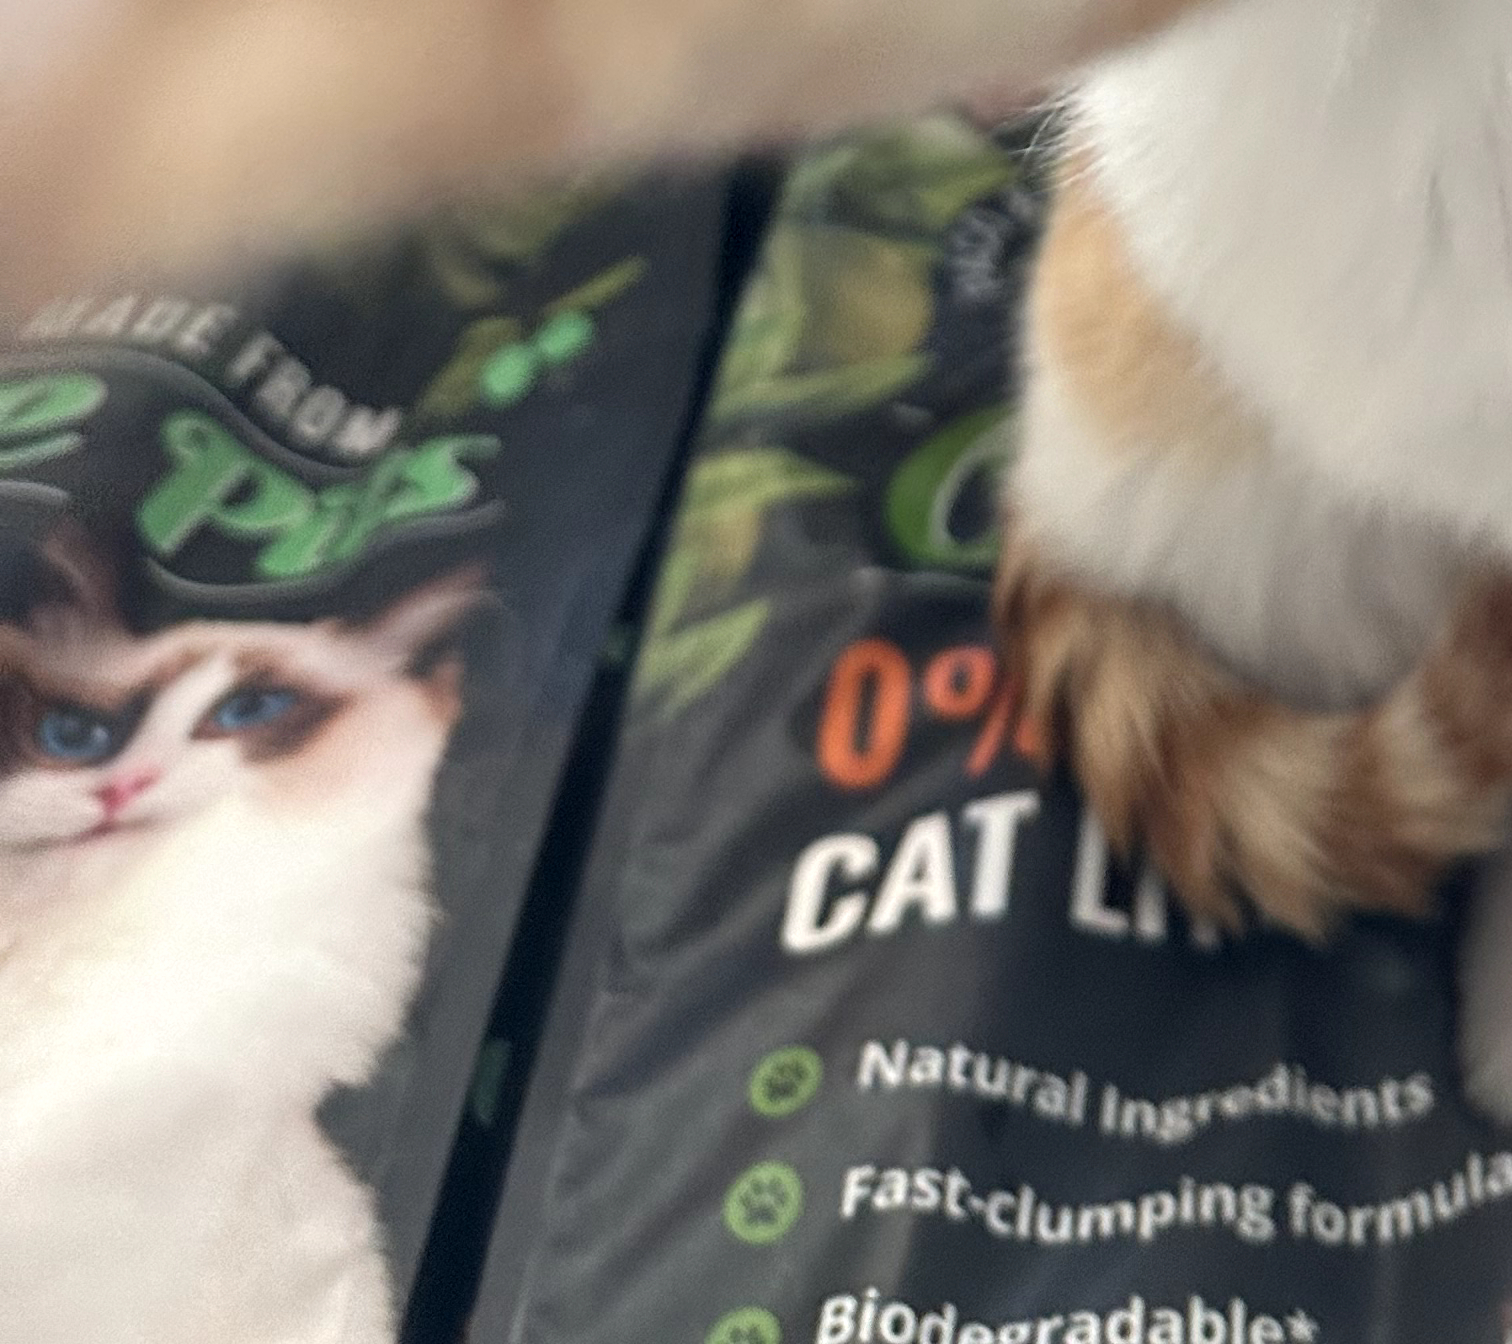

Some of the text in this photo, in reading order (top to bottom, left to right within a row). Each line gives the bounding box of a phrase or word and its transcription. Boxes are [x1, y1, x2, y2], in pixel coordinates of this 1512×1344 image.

[816, 637, 1047, 792] 0%
[779, 789, 1042, 956] CAT
[856, 1038, 1087, 1126] Natural
[840, 1164, 1276, 1244] Fast-clumping
